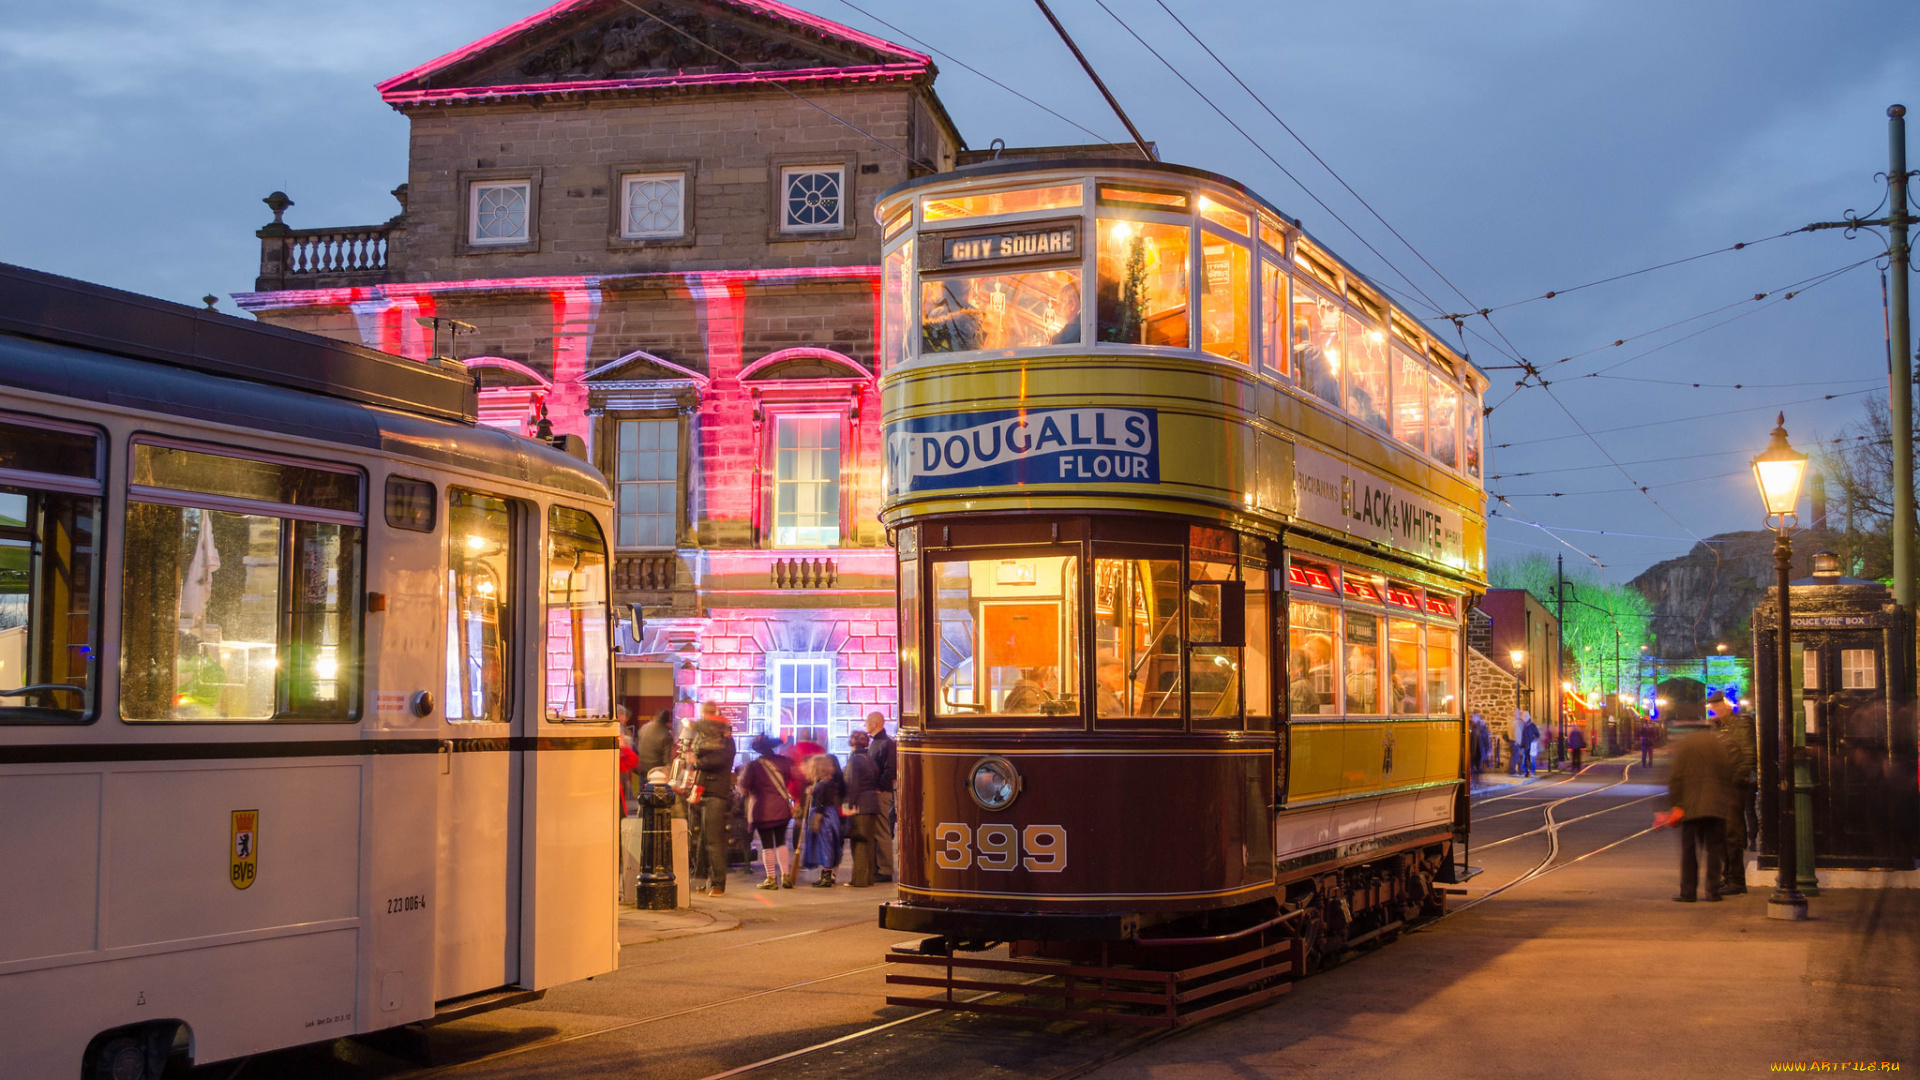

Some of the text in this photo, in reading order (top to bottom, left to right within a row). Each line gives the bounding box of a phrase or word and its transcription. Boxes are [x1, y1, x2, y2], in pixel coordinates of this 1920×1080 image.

[952, 231, 1072, 260] CITY SQUARE
[1059, 455, 1150, 479] FLOUR
[1298, 471, 1339, 503] BUCHANANS
[1341, 474, 1392, 533] BLACK
[1393, 504, 1399, 528] &
[1401, 500, 1442, 549] WHITE
[1791, 617, 1865, 626] POLICE BOX
[936, 822, 1067, 872] 399
[233, 861, 254, 882] BVB
[405, 894, 426, 912] 006-4
